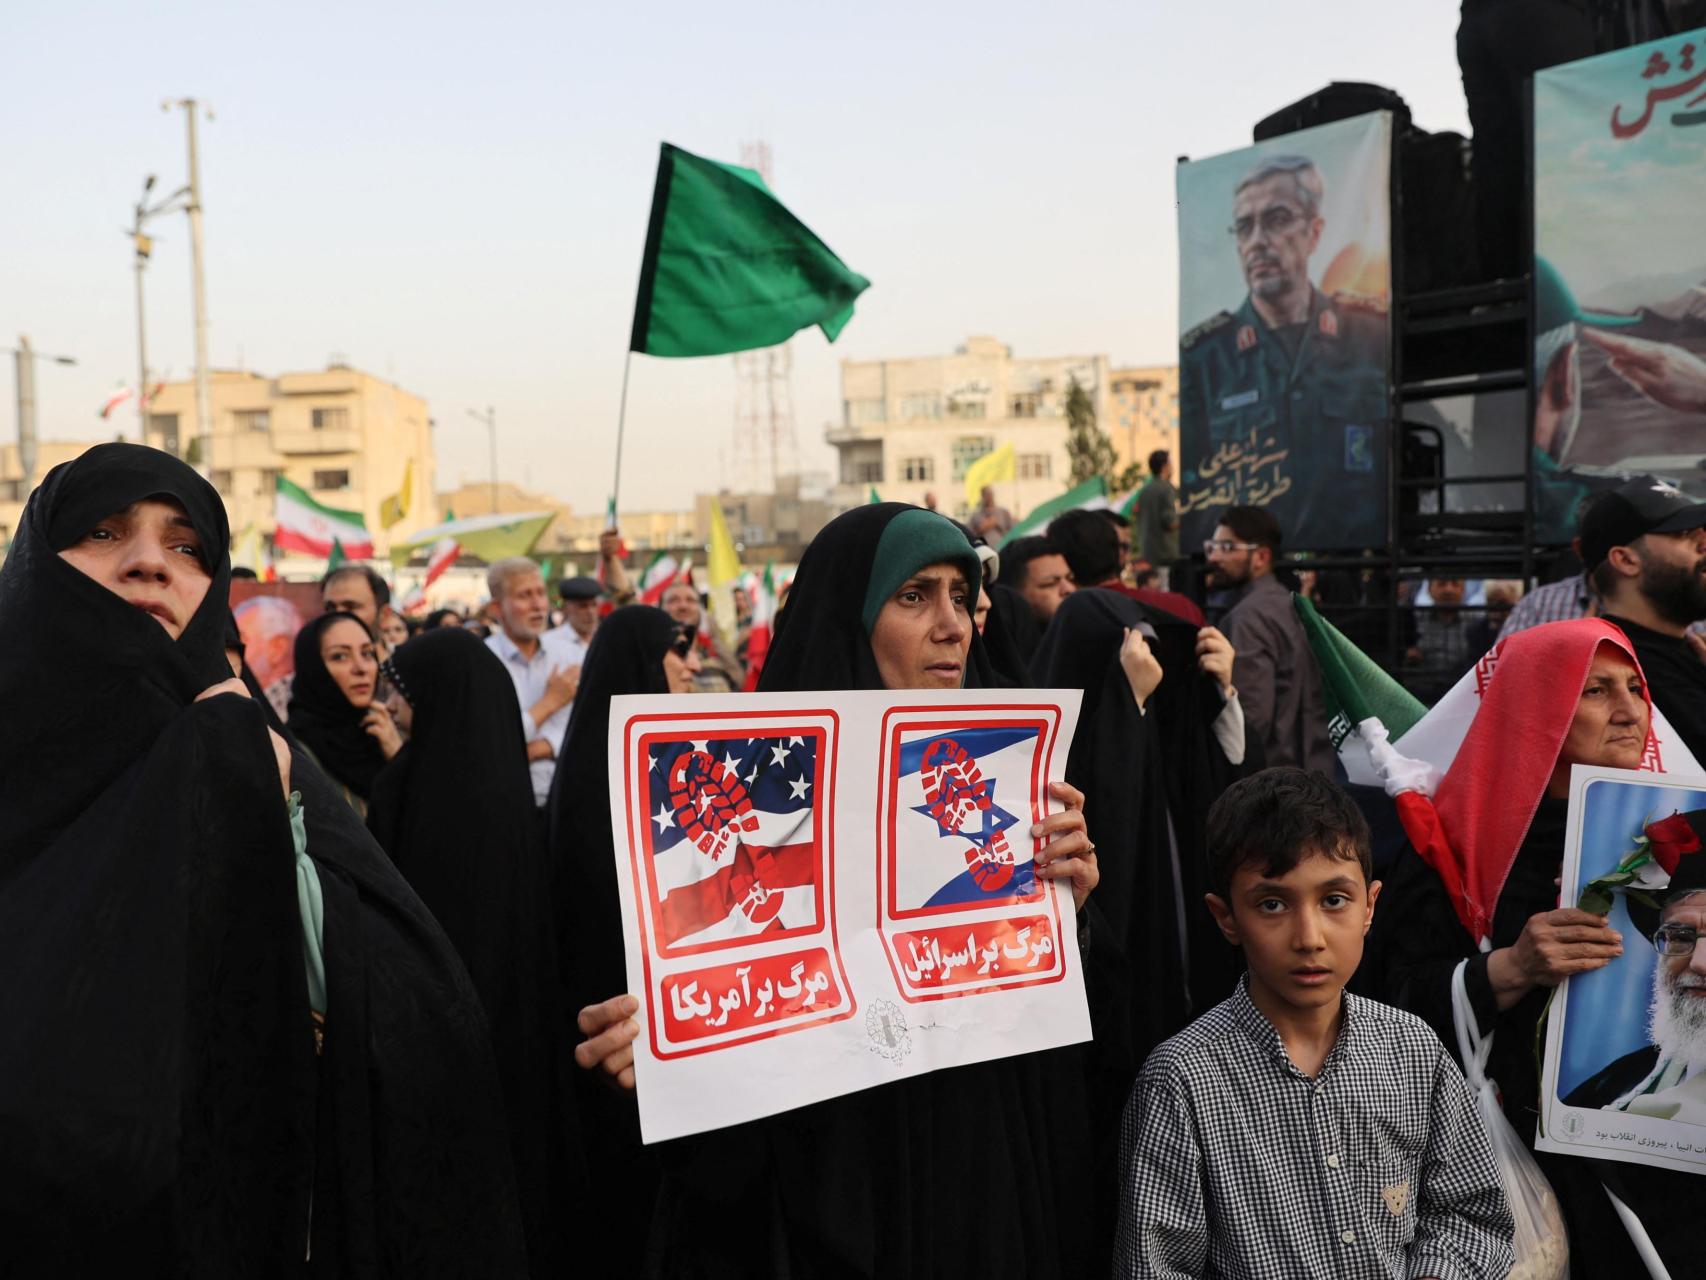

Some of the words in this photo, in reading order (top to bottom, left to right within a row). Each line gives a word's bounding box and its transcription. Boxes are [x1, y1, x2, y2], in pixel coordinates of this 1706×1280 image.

[904, 932, 976, 982] اسرائیل
[976, 939, 999, 975] بر
[1003, 926, 1053, 967] مرگ
[670, 965, 752, 1026] آمریکا
[753, 976, 775, 1018] بر
[777, 961, 829, 1006] مرگ
[1595, 1130, 1608, 1140] بود
[1610, 1131, 1636, 1141] انقلاب
[1638, 1137, 1668, 1149] پیروزی
